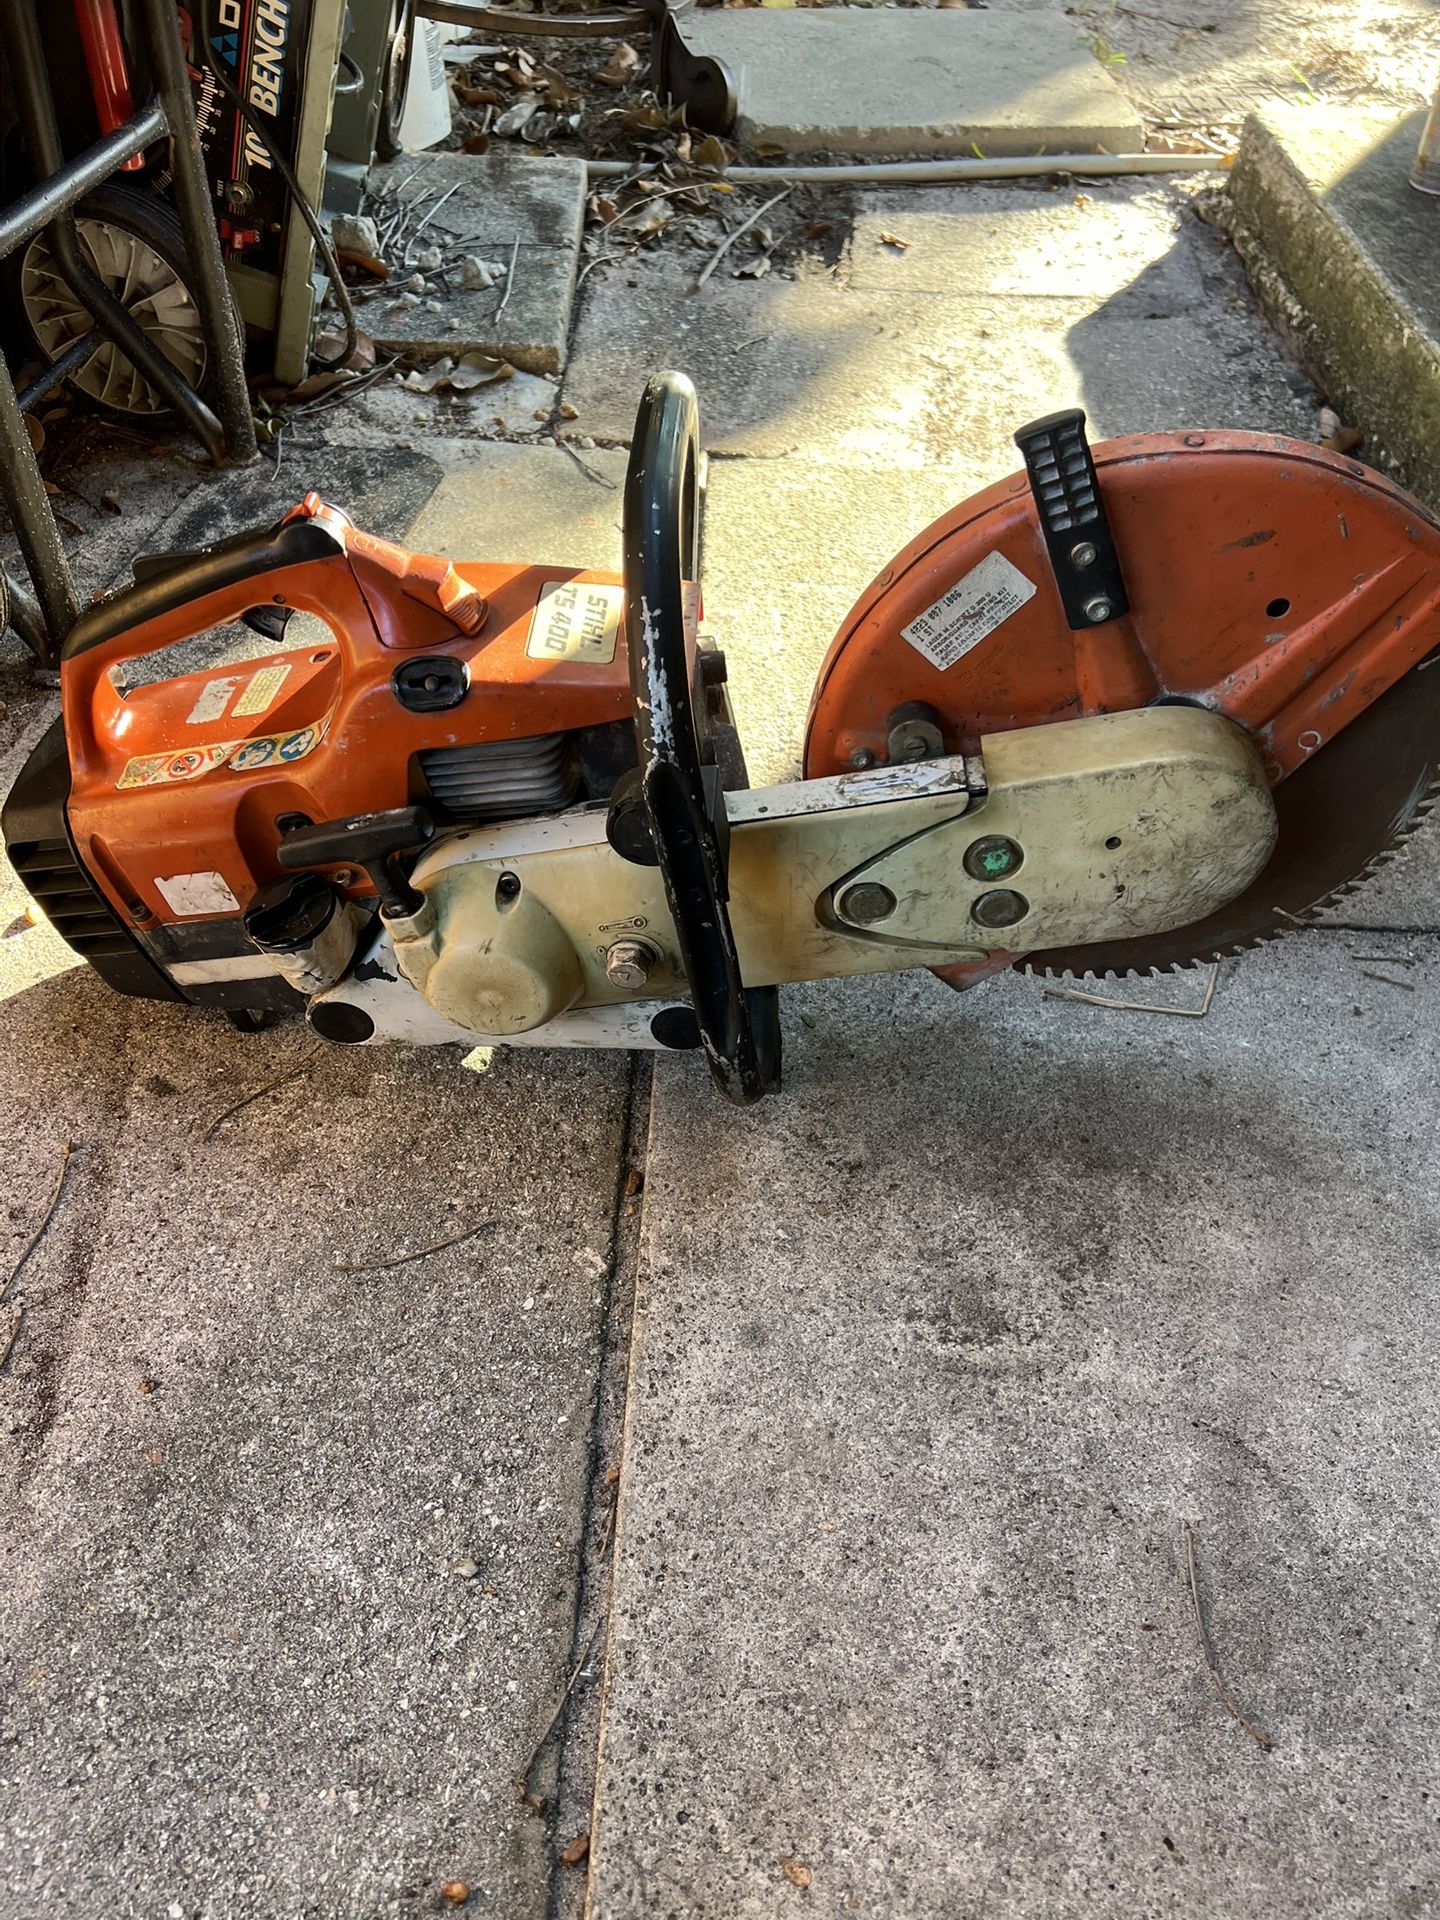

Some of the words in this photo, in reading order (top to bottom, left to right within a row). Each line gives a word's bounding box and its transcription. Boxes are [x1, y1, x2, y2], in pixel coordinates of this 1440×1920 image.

[250, 0, 289, 115] BENCH
[216, 180, 224, 196] RESET
[555, 587, 577, 610] TS
[545, 612, 572, 652] 400
[580, 595, 609, 648] STIHL
[908, 617, 928, 636] 4223
[924, 625, 936, 636] ST
